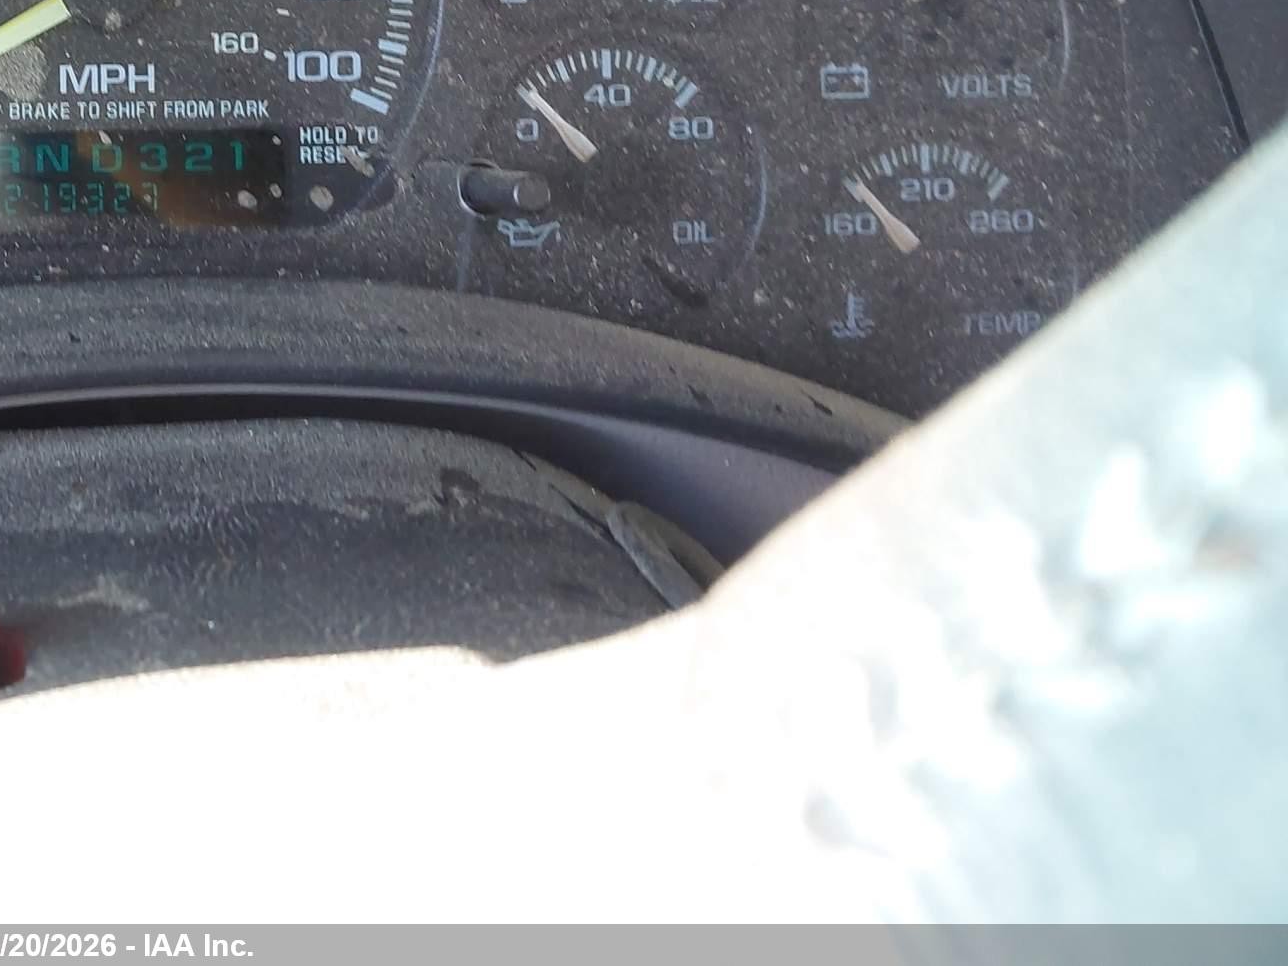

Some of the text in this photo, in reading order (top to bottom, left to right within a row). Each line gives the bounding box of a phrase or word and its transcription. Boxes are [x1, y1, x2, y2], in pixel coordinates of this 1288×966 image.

[212, 33, 259, 55] 160
[286, 50, 362, 81] 100
[59, 63, 155, 92] MPH
[942, 74, 1033, 98] VOLTS
[583, 84, 631, 107] 40
[9, 102, 70, 120] BRAKE
[78, 102, 100, 119] TO
[106, 102, 156, 118] SHIFT
[163, 102, 214, 118] FROM
[220, 101, 269, 117] PARK
[299, 126, 378, 145] HOLD TO
[516, 119, 540, 141] 0
[669, 117, 713, 141] 80
[36, 146, 70, 171] N
[92, 142, 122, 171] D
[140, 142, 168, 171] 3
[184, 141, 213, 171] 2
[230, 140, 244, 170] 1
[900, 179, 955, 202] 210
[674, 221, 713, 243] OIL
[824, 213, 878, 235] 160
